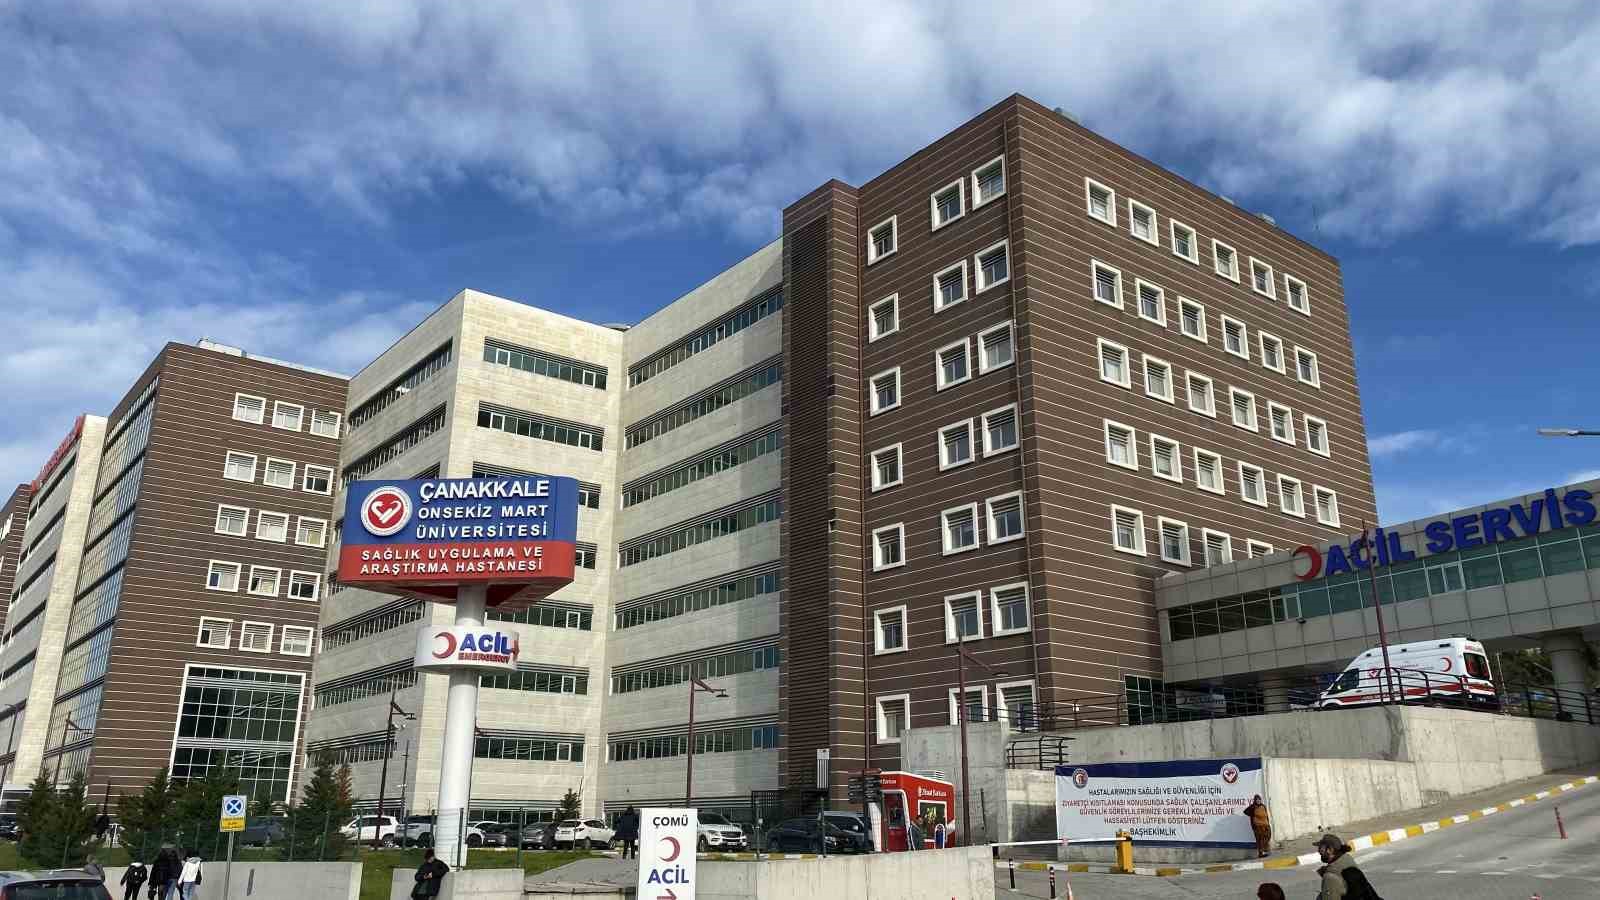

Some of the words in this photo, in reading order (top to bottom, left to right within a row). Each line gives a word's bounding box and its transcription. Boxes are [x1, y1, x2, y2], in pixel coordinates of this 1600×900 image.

[420, 480, 549, 503] ÇANAKKALE
[418, 504, 492, 519] ONSEKİZ
[501, 505, 548, 517] MART
[416, 520, 547, 539] ÜNİVERSİTESİ
[1325, 528, 1415, 576] ACİL
[1424, 488, 1597, 554] SERVİS
[361, 548, 420, 561] SAĞLIK
[428, 547, 515, 559] UYGULAMA
[524, 546, 543, 557] VE
[360, 562, 449, 575] ARAŞTIRMA
[456, 558, 543, 572] HASTANESİ
[460, 632, 512, 655] ACİL
[1089, 788, 1137, 796] HASTALARIMIZIN
[1138, 786, 1161, 795] SAĞLIĞI
[653, 814, 688, 829] ÇOMÜ
[1130, 827, 1176, 837] BAŞHEKİMLİK
[647, 864, 690, 884] ACİL
